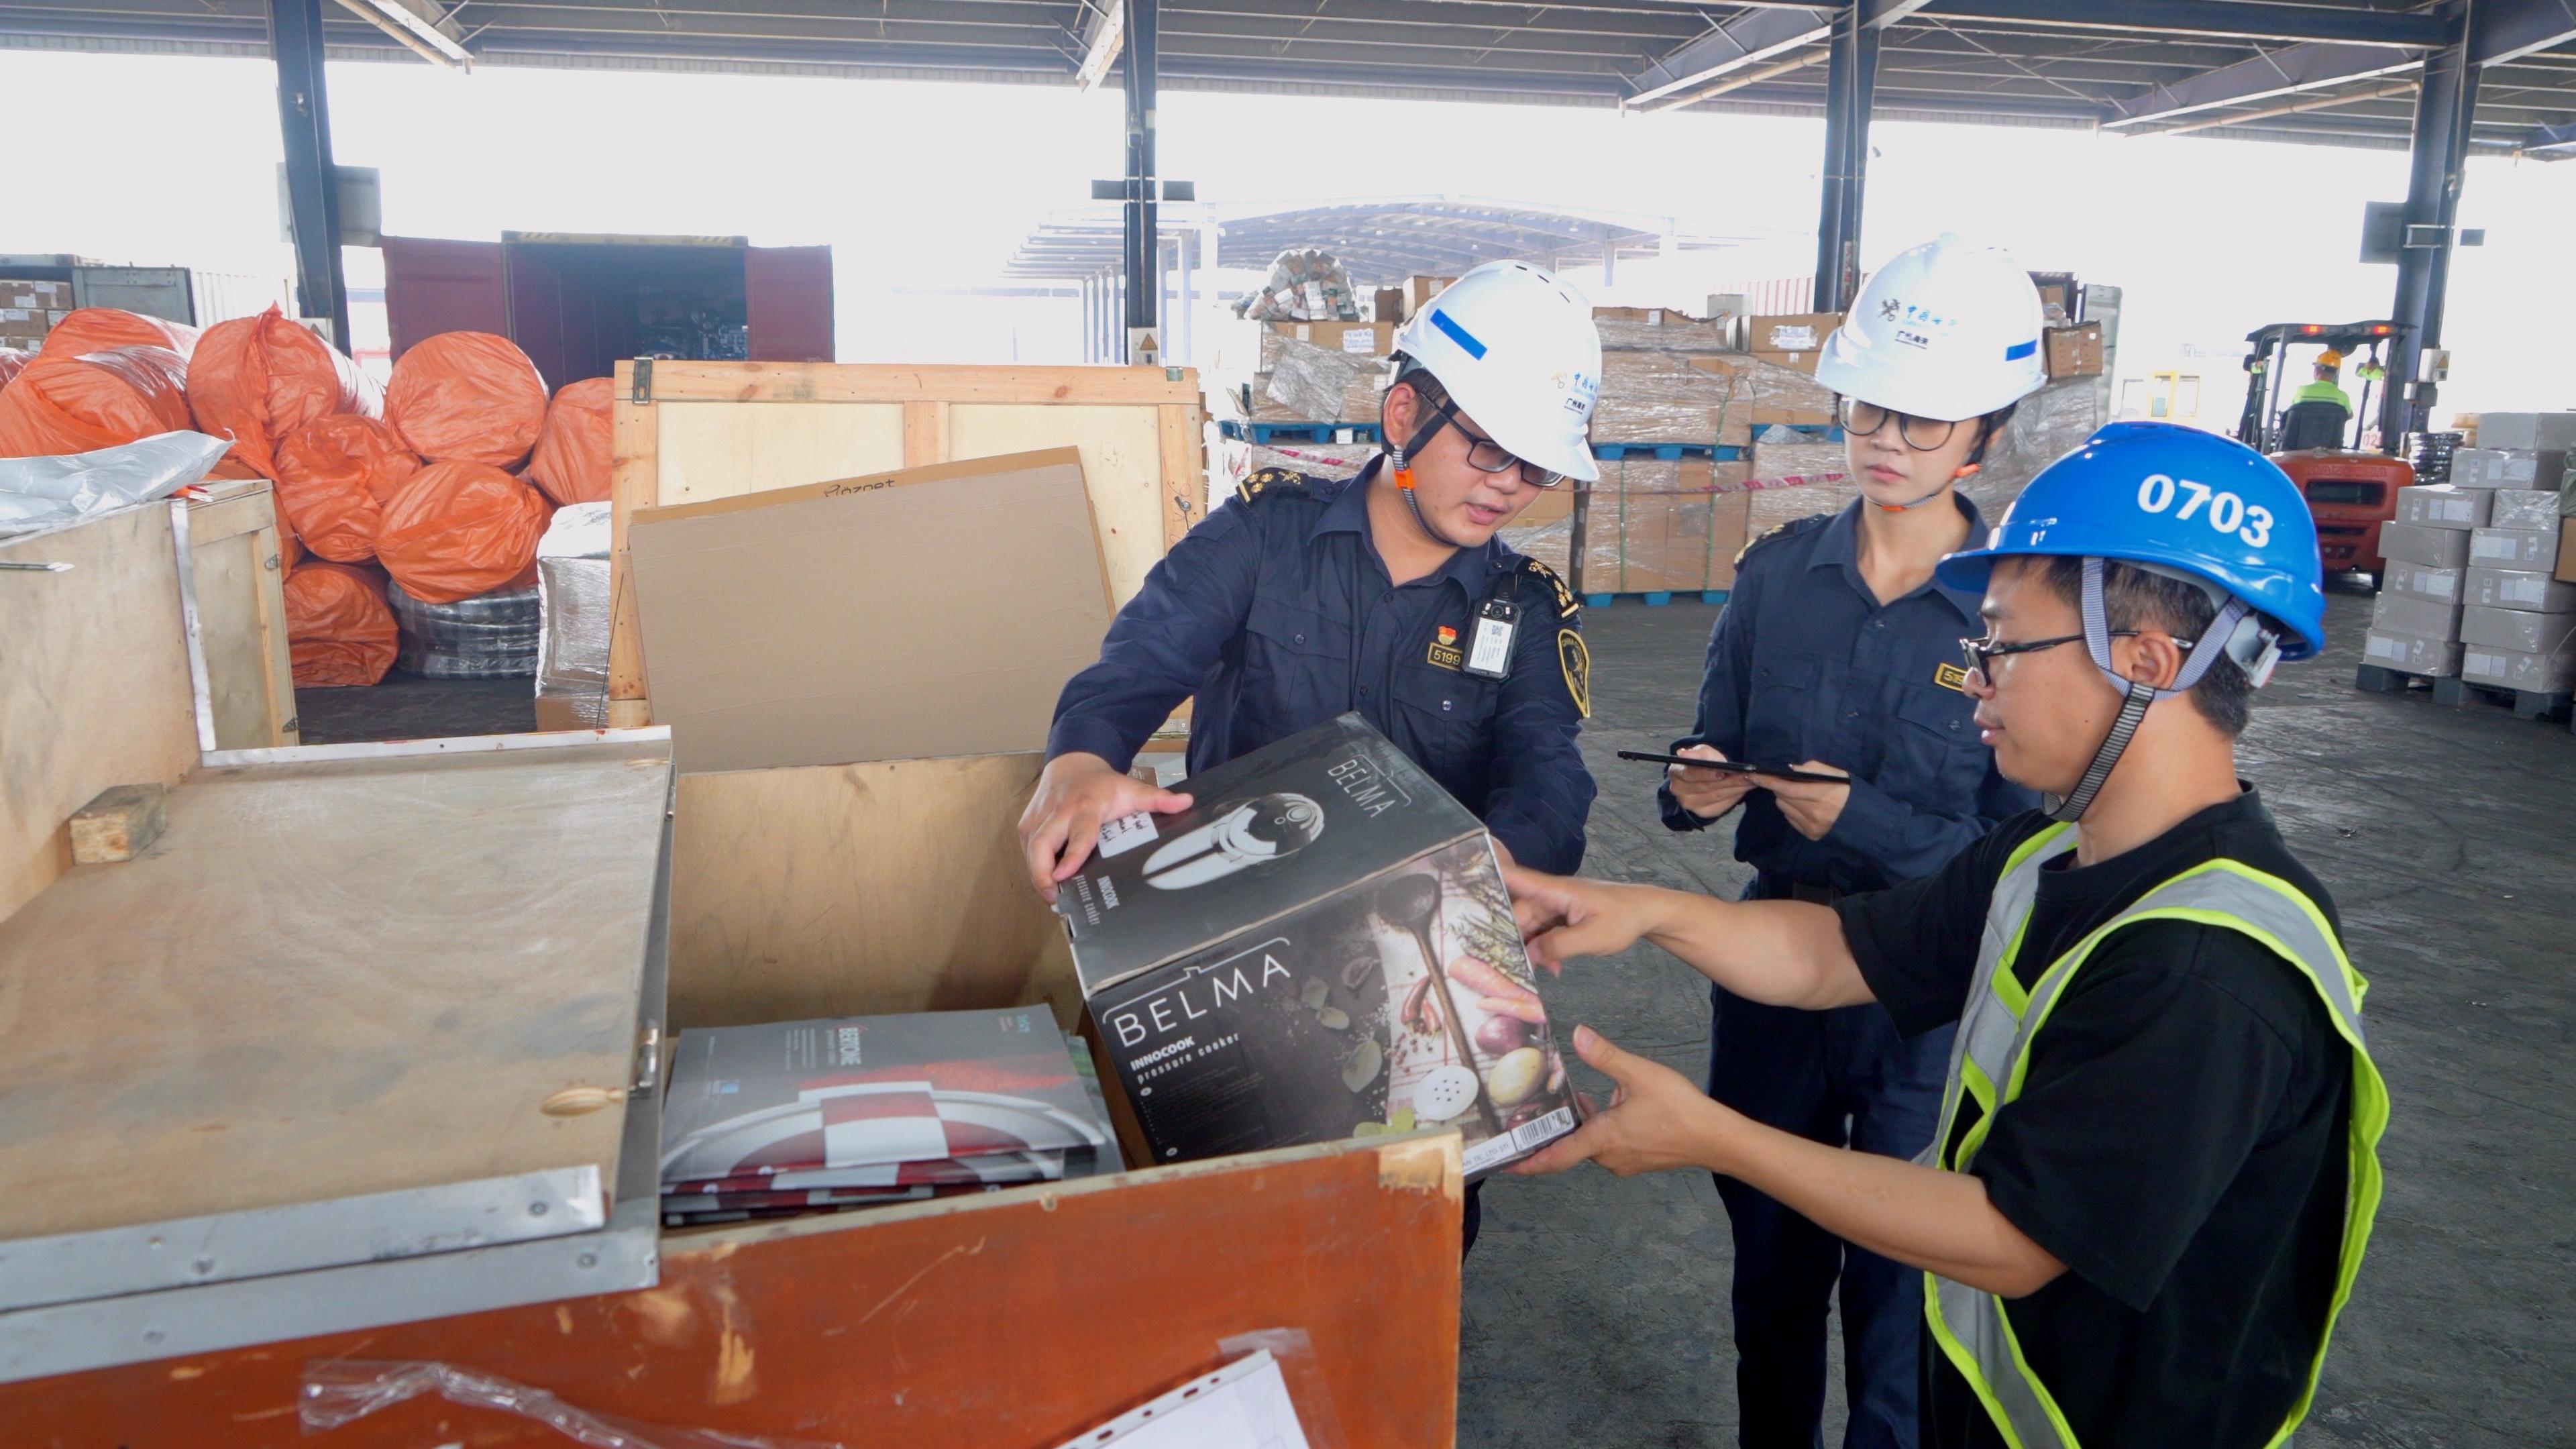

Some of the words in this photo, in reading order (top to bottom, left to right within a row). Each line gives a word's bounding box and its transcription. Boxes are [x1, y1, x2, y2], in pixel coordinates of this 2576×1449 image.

[2363, 433, 2383, 446] 02
[2137, 474, 2273, 548] 0703
[1433, 649, 1460, 665] 5199
[1328, 759, 1395, 818] BELMA
[1114, 953, 1291, 1048] BELMA
[1130, 1036, 1195, 1071] INNOCOOK
[1136, 1053, 1192, 1085] pressure
[1197, 1032, 1239, 1057] cooker
